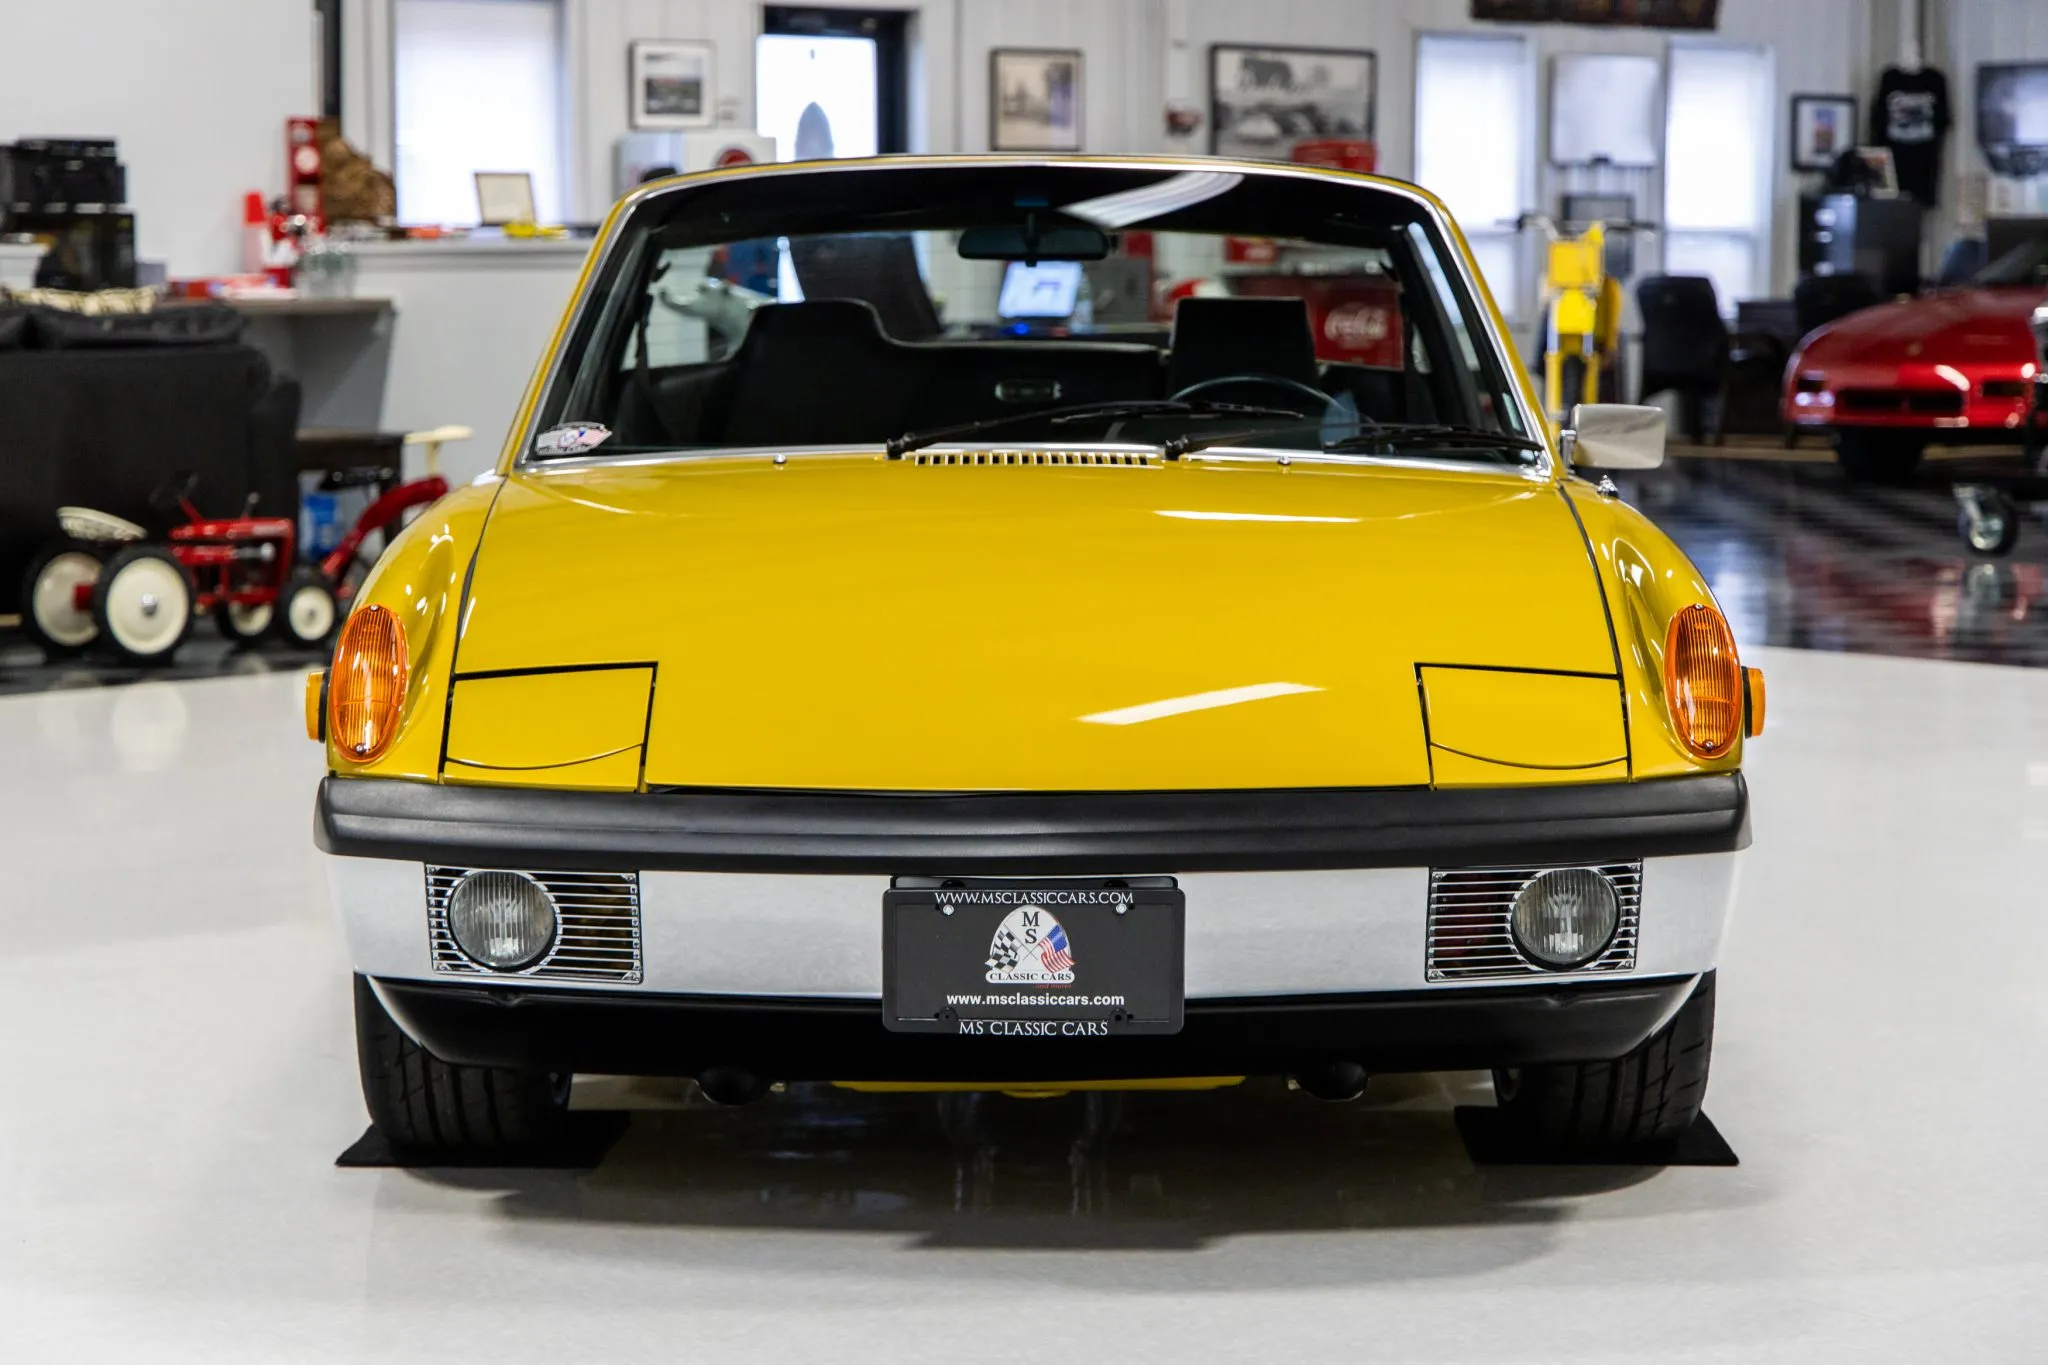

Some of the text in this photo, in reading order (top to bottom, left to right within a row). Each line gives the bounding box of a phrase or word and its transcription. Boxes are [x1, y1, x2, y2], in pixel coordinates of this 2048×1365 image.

[934, 892, 1134, 904] WWW.MSCLASSICCARS.COM
[989, 973, 1072, 981] CLASSIC CARS
[946, 992, 1125, 1006] www.msclassiccars.com
[959, 1021, 1109, 1036] MS CLASSIC CARS
